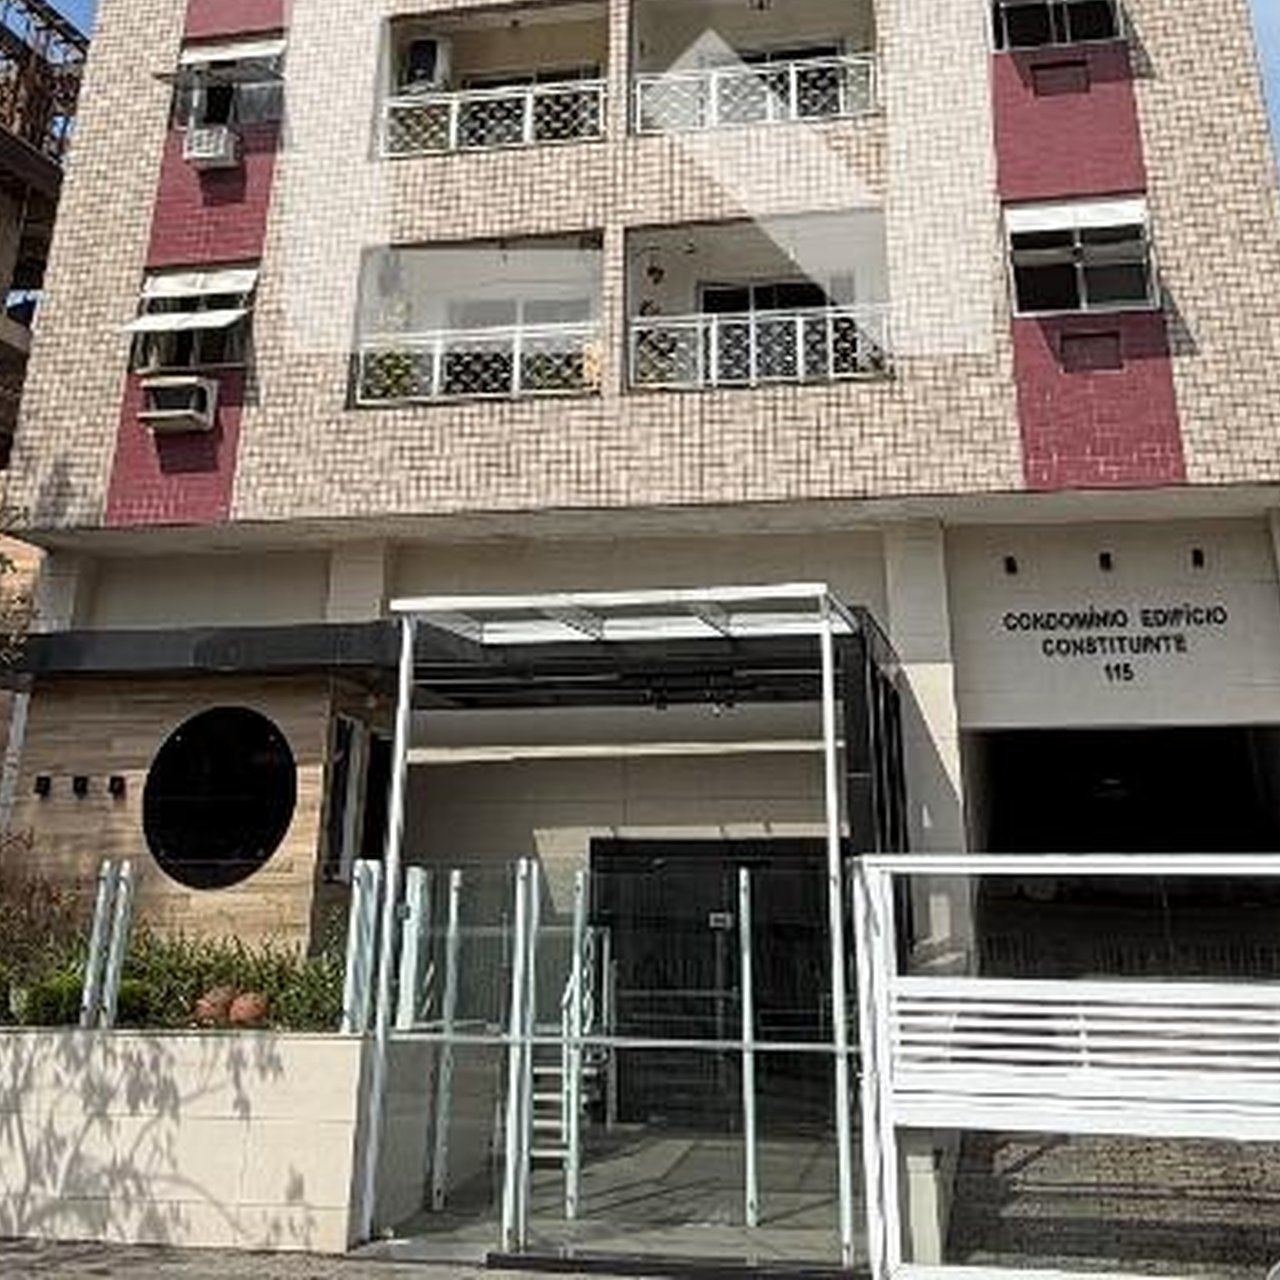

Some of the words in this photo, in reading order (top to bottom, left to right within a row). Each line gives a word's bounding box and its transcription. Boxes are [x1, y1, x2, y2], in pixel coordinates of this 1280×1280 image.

[1003, 605, 1129, 631] CONDOMÍNIO
[1140, 602, 1228, 628] EDIFÍCIO
[1042, 635, 1188, 656] CONSTITUINTE
[1103, 663, 1135, 682] 115
